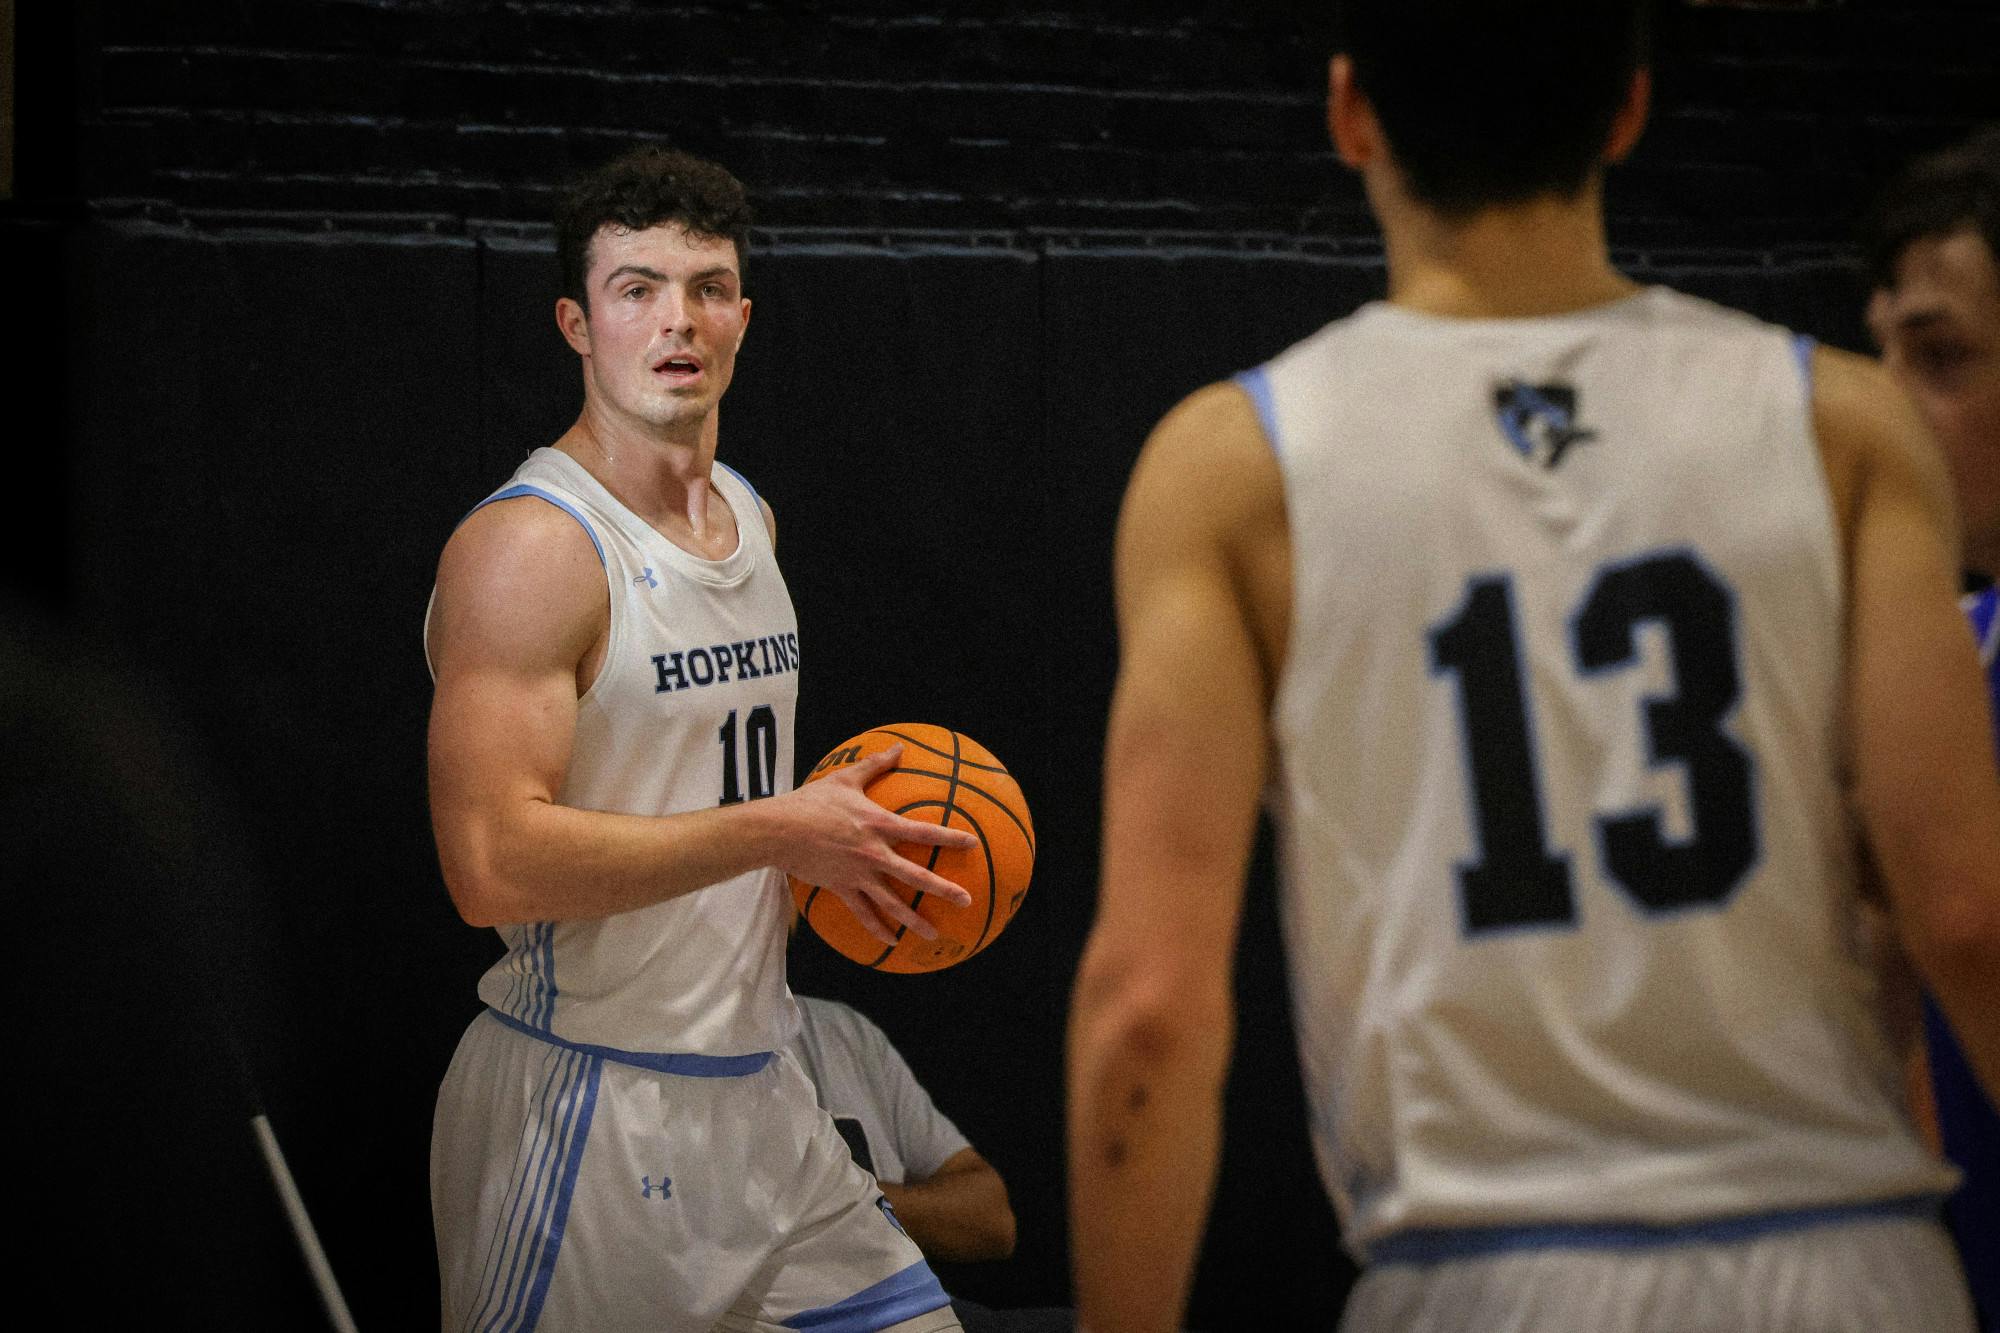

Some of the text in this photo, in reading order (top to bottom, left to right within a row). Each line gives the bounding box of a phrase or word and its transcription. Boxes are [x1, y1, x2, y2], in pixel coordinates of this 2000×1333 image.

[651, 632, 799, 693] HOPKINS
[718, 704, 777, 807] 10
[1425, 547, 1761, 939] 13
